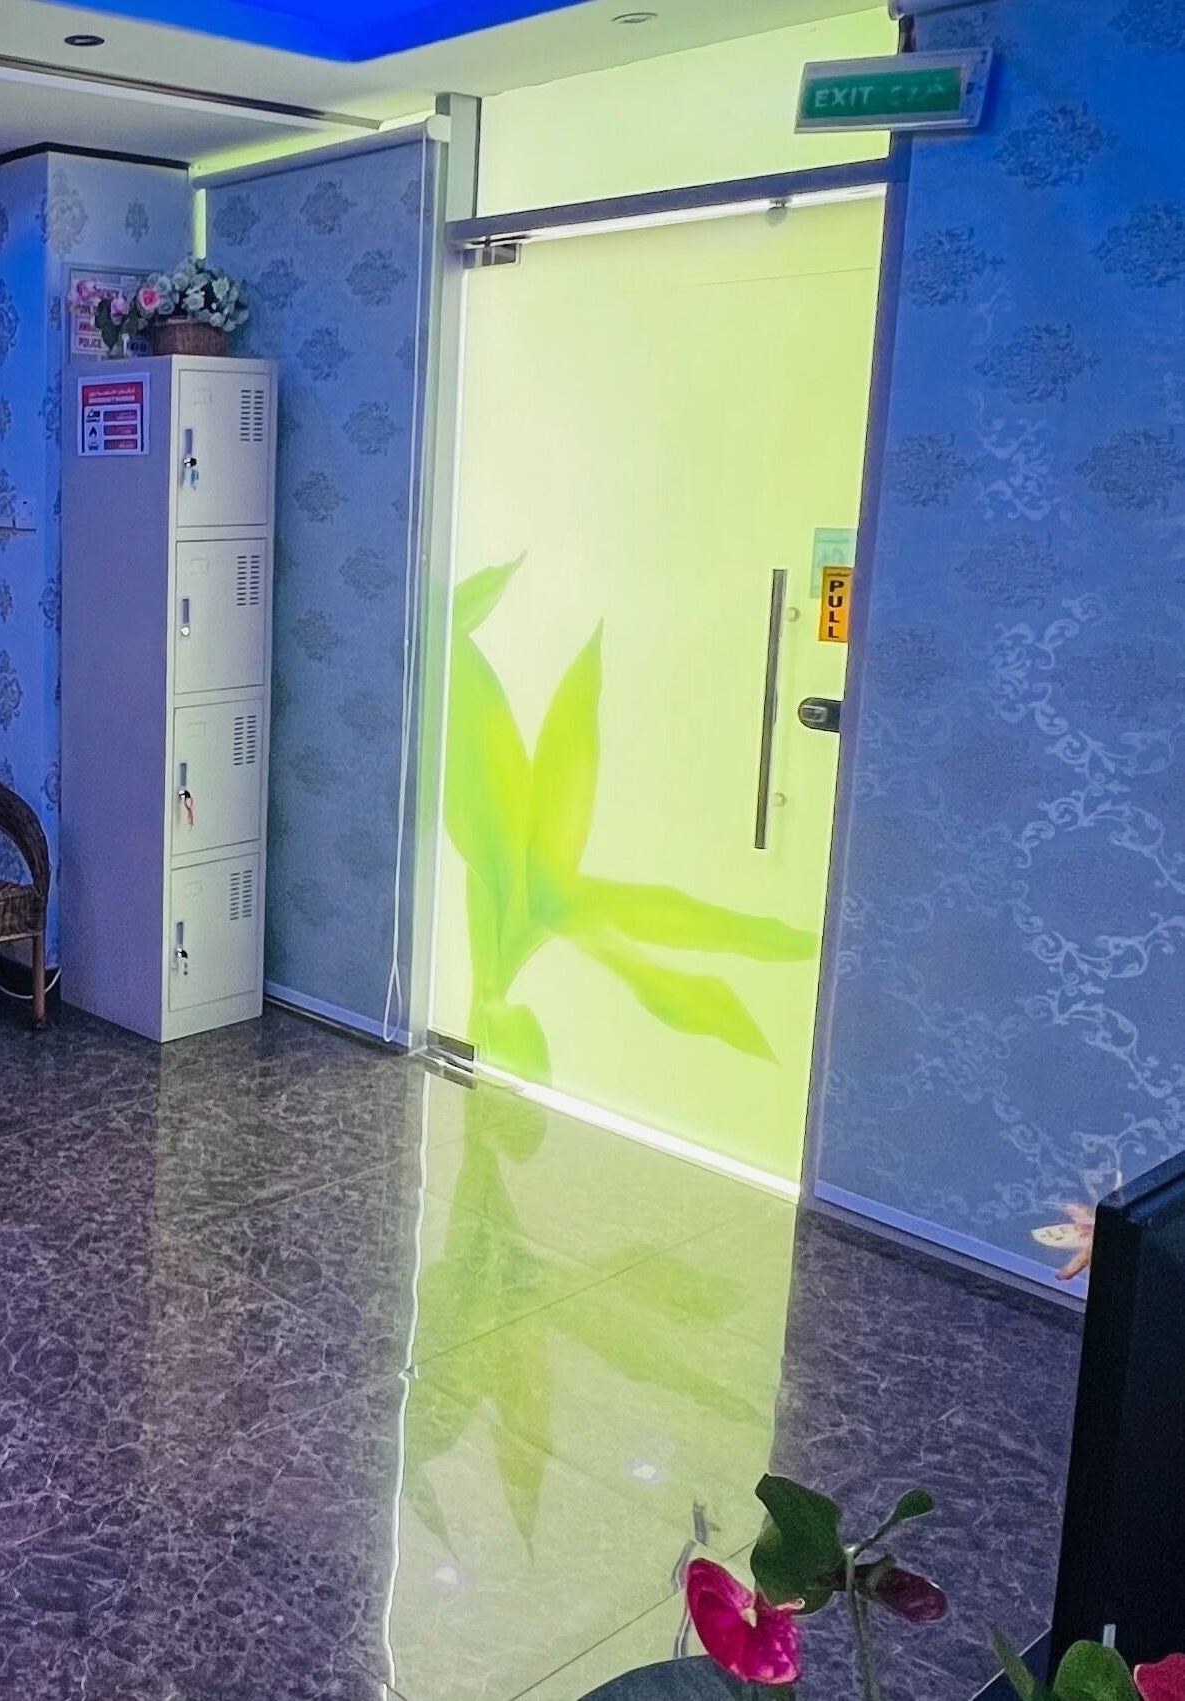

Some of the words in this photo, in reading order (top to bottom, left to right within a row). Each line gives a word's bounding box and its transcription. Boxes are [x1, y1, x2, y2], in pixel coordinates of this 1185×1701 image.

[815, 86, 874, 107] EXIT
[78, 337, 102, 348] POLICE
[828, 580, 845, 639] PULL
